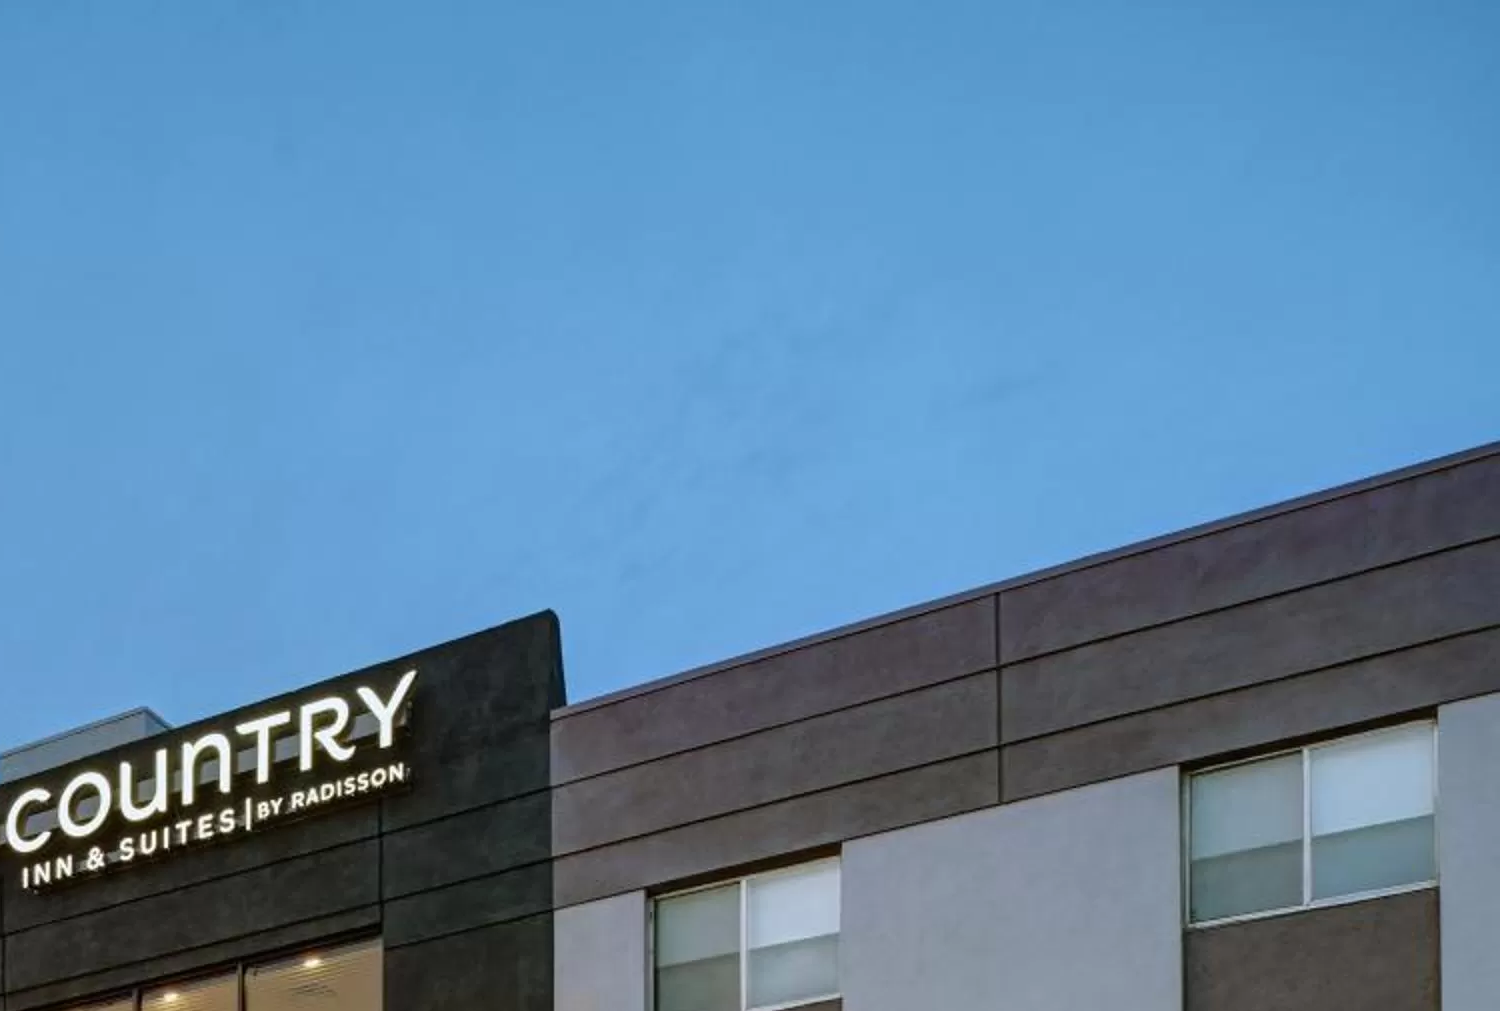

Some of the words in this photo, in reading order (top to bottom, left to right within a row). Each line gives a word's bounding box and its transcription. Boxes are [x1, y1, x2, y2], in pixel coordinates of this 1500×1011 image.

[6, 670, 418, 854] COUNTRY
[21, 854, 74, 889] INN
[86, 846, 105, 870] &
[119, 807, 236, 862] SUITES
[257, 797, 283, 820] BY
[291, 762, 405, 810] RADISSON
